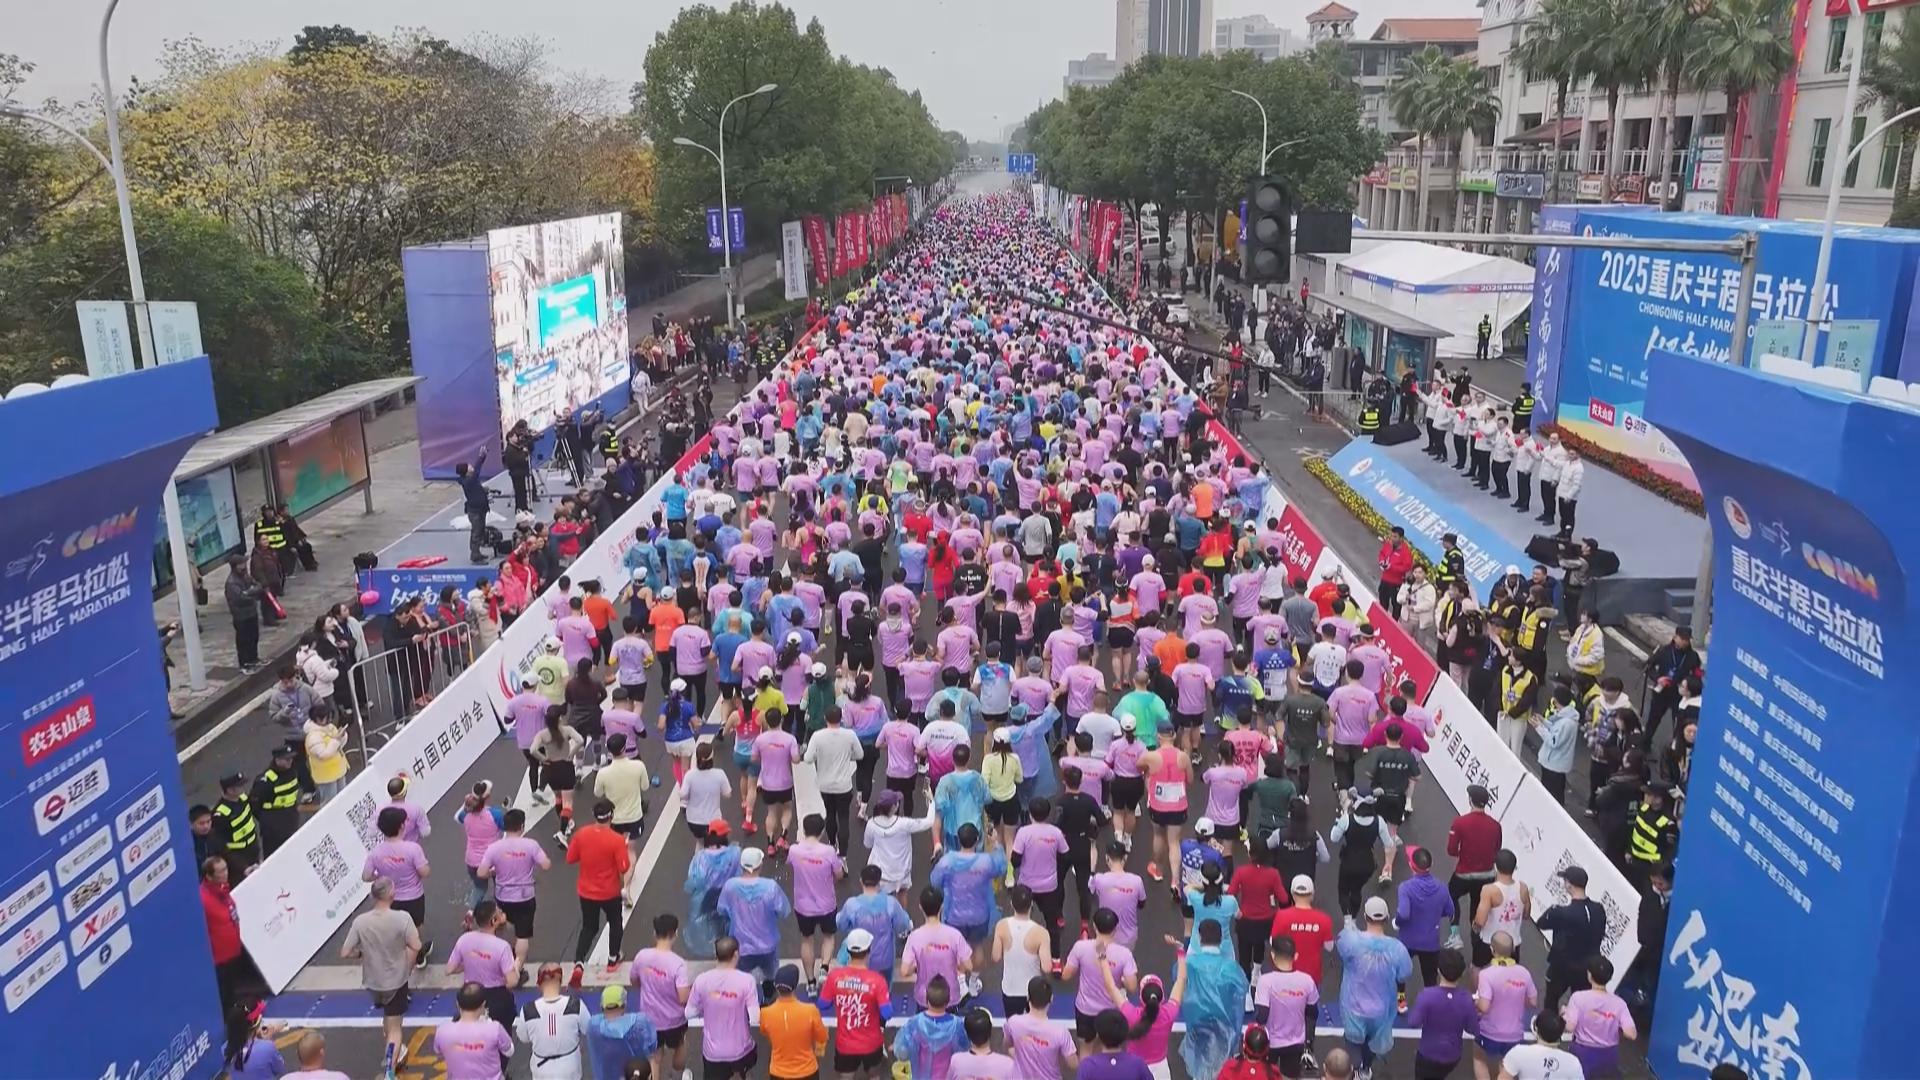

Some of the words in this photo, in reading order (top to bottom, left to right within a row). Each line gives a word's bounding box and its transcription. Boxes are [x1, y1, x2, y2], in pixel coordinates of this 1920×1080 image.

[1639, 301, 1684, 323] CHONGQING
[1686, 312, 1709, 327] HALF
[0, 551, 130, 643] 半程马拉松
[31, 617, 65, 645] HALF
[69, 585, 131, 626] MARATHON
[1731, 545, 1883, 661] 重庆半程马拉松
[1732, 579, 1784, 619] CHONGQING
[1787, 612, 1815, 636] HALF
[1819, 629, 1884, 680] MARATHON
[28, 705, 92, 757] 农夫山泉
[412, 699, 483, 780] 中国田径协会
[1440, 723, 1500, 810] 中国田径协会
[836, 992, 863, 1007] RUN
[841, 1003, 867, 1018] FOR
[847, 1014, 870, 1030] LIFE
